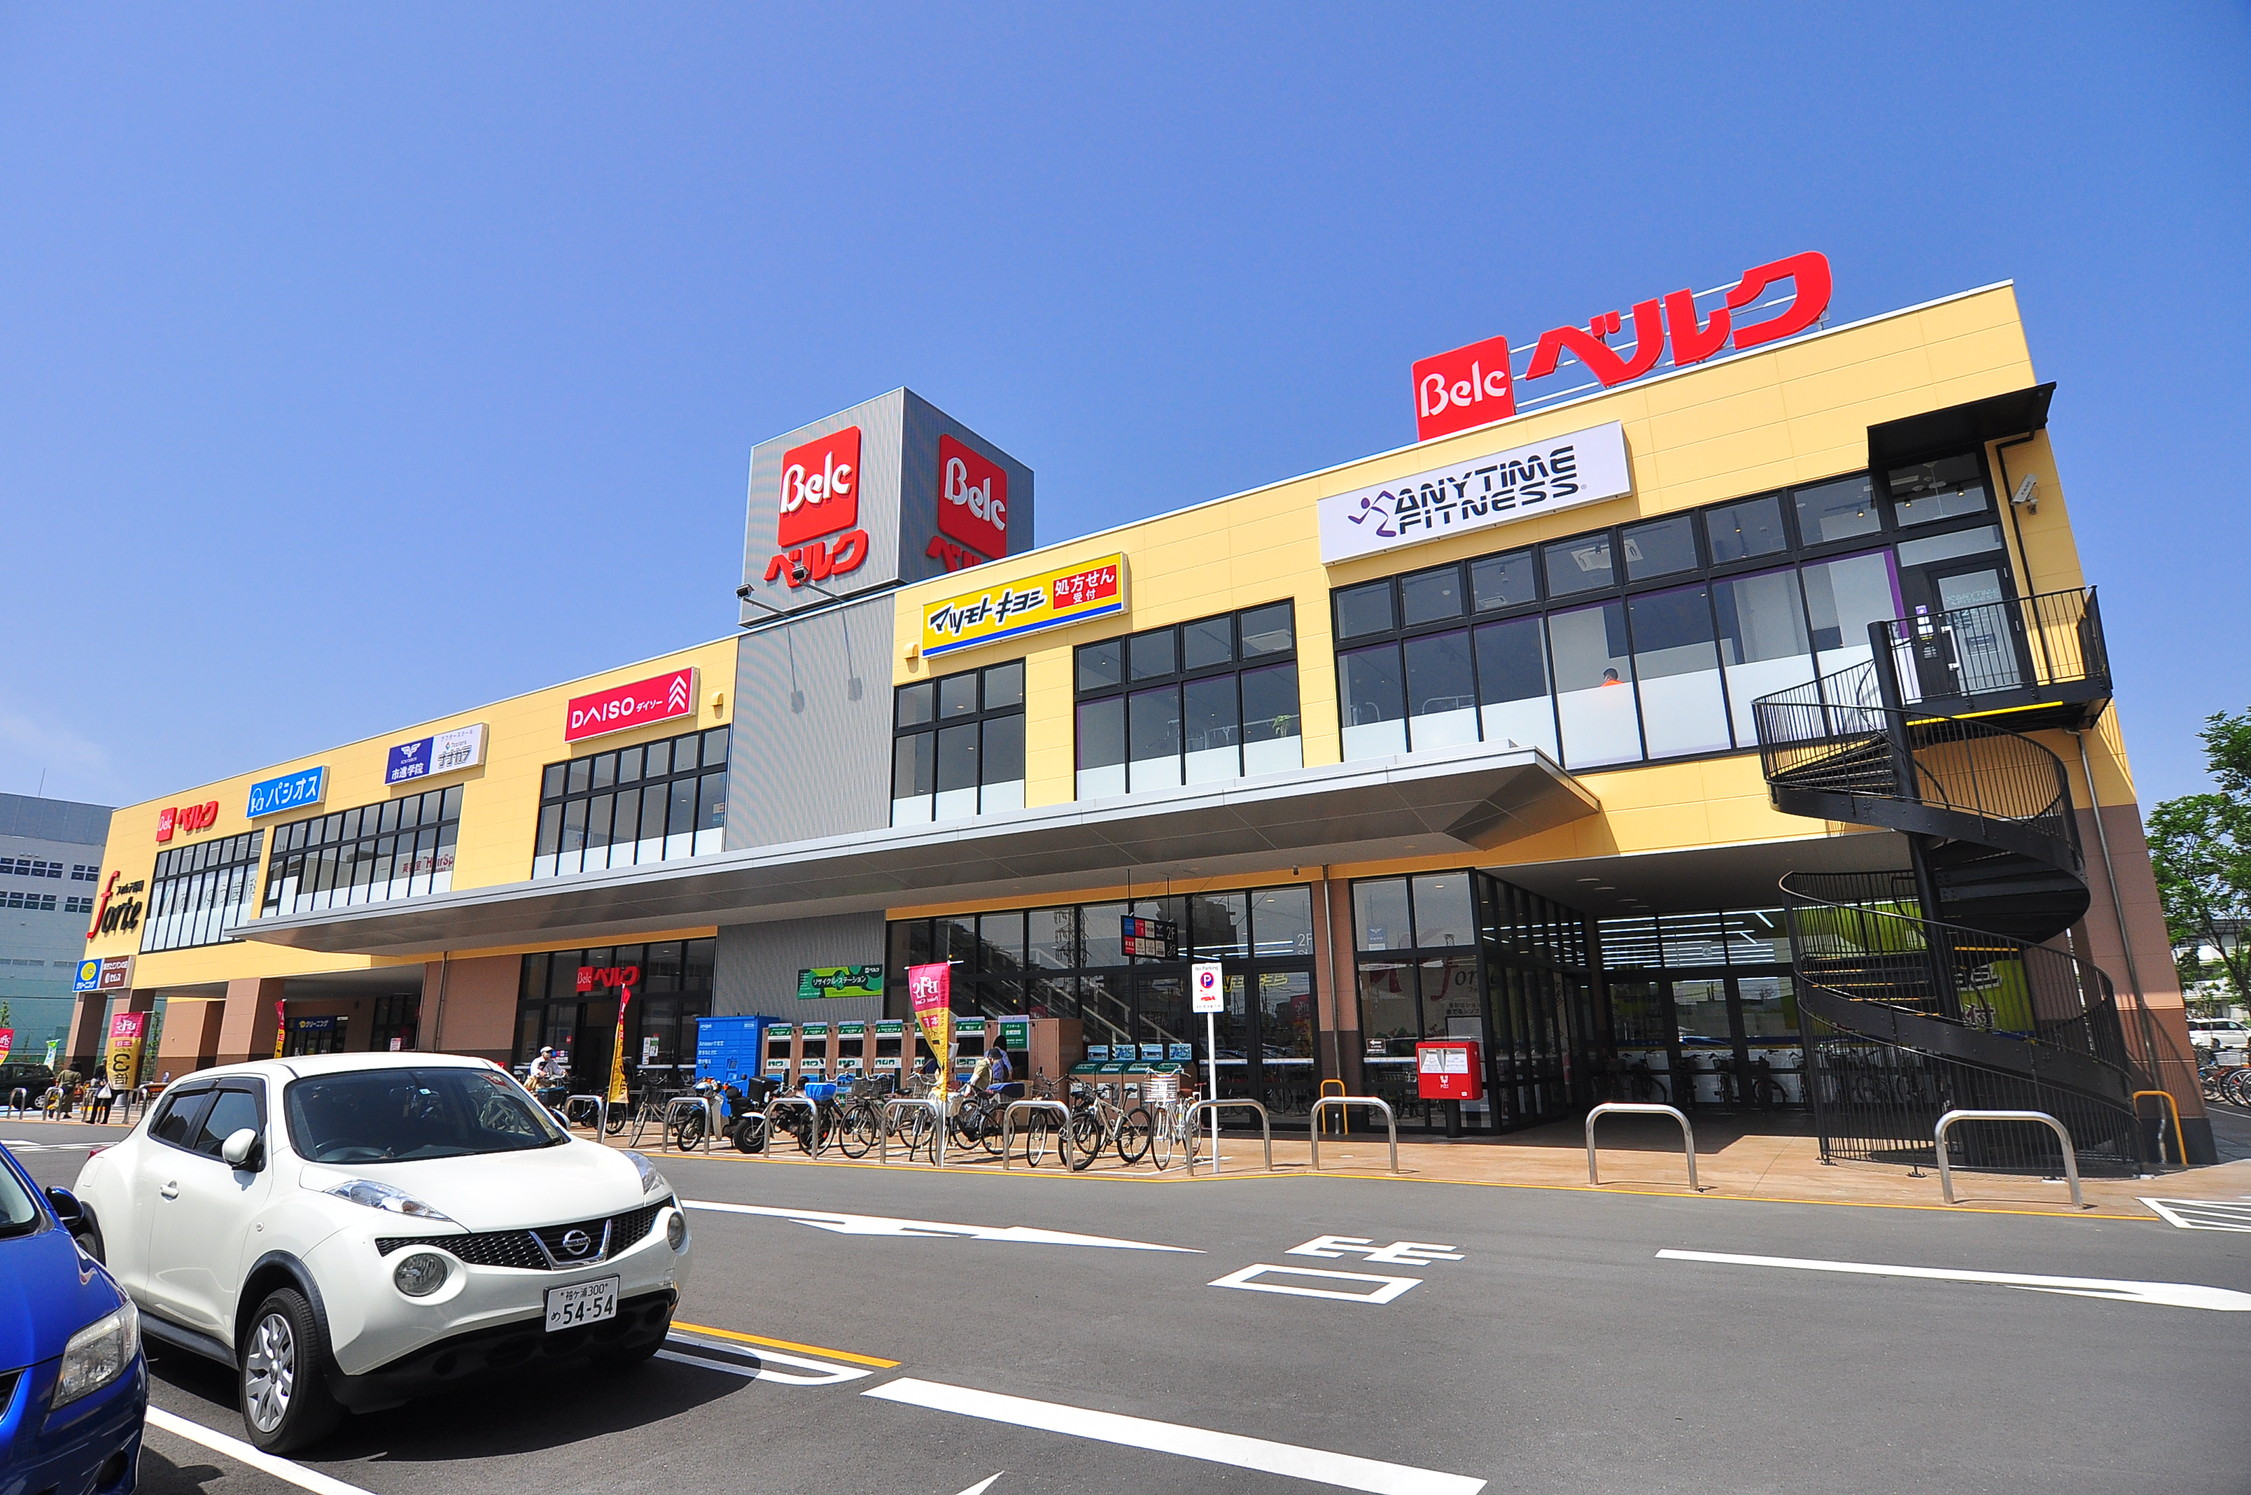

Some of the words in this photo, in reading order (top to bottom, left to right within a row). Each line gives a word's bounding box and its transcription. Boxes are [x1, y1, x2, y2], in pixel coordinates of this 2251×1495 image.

[1419, 360, 1507, 418] Belc
[1525, 250, 1832, 387] ベルク
[780, 451, 852, 514] Belc
[944, 457, 1006, 531] Belc
[1395, 445, 1577, 515] ANYTIME
[1399, 478, 1580, 535] FITNESS
[764, 528, 869, 588] ベルク
[1055, 568, 1115, 596] 処方せん
[1073, 589, 1096, 604] 受付
[929, 590, 1046, 635] マツモトキヨシ
[571, 697, 635, 729] DAISO
[636, 699, 664, 713] ダイソー
[391, 762, 425, 781] 市進学院
[265, 774, 318, 808] パシオス
[175, 800, 219, 832] ベルク
[86, 870, 143, 938] forte
[1166, 926, 1176, 941] 2F
[1297, 933, 1312, 947] 2F
[577, 971, 591, 985] Belc
[593, 966, 641, 987] ベルク
[551, 1312, 561, 1323] め
[562, 1294, 614, 1325] 54-54
